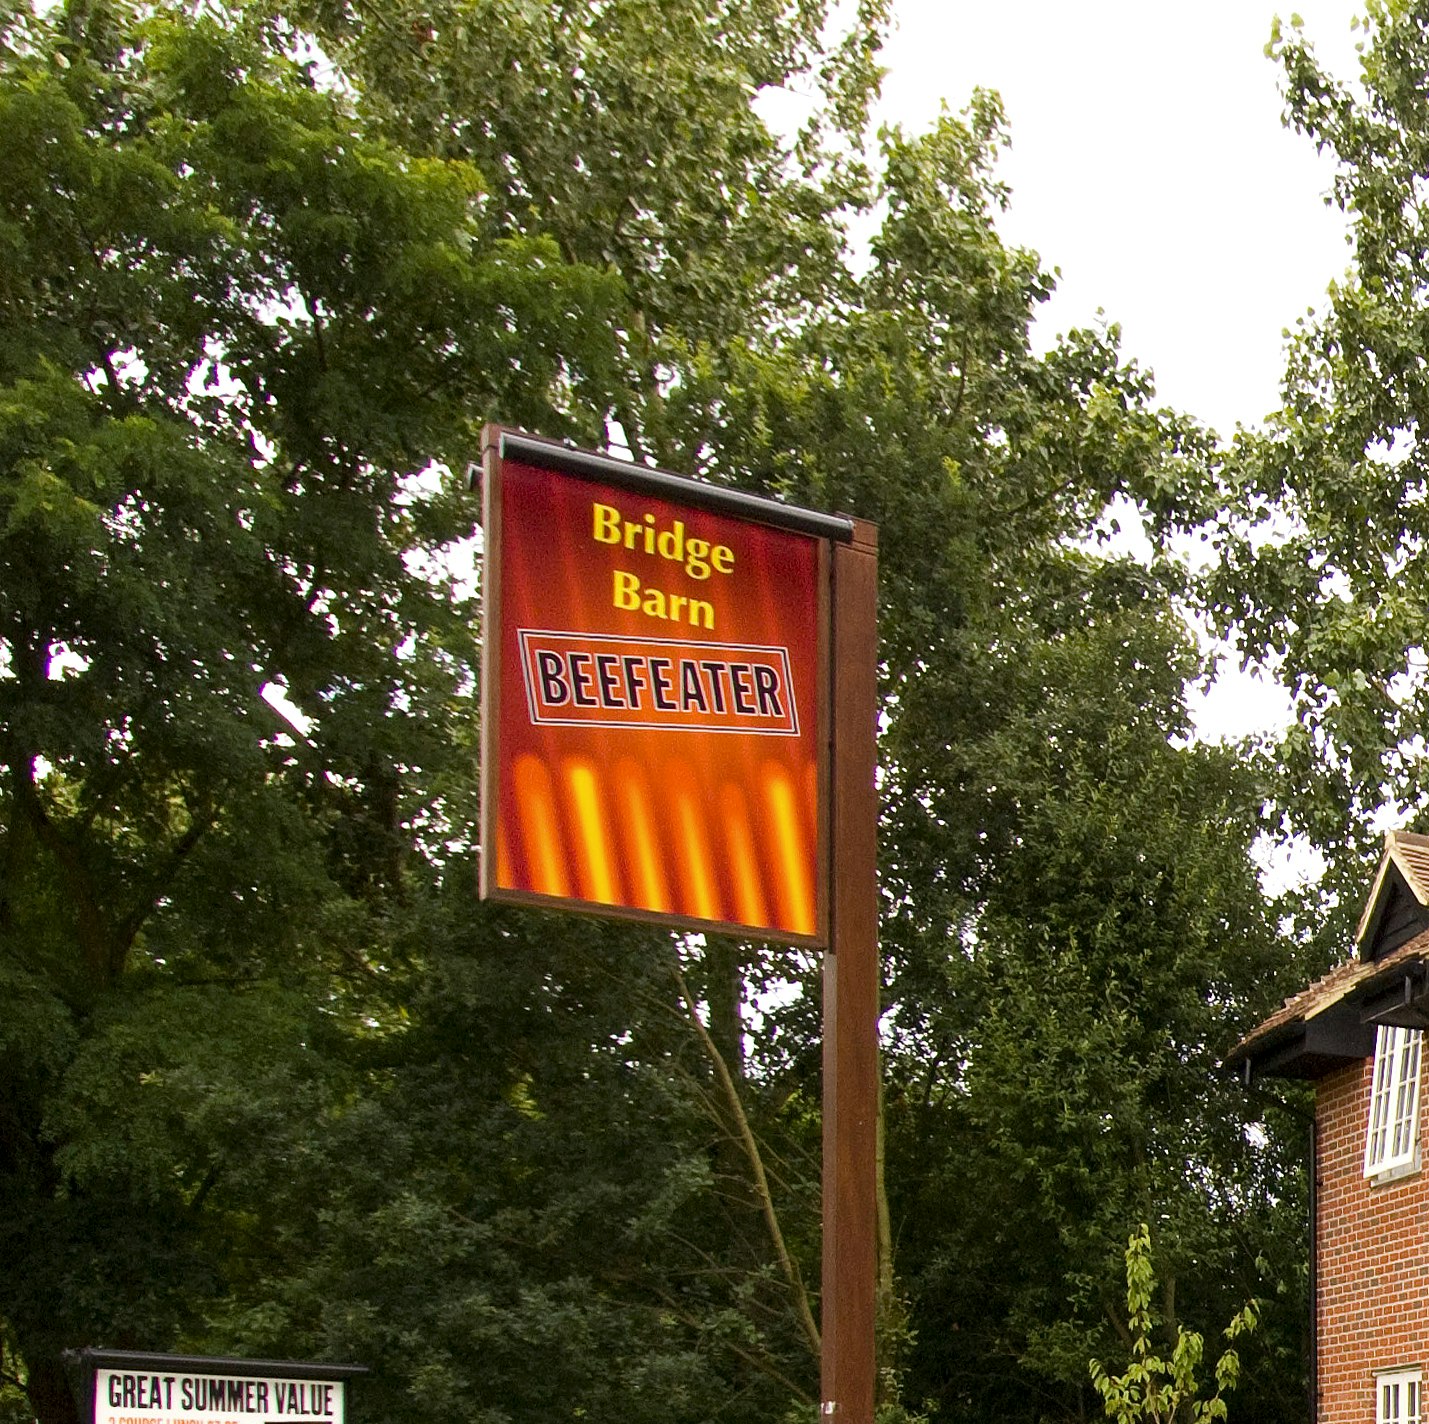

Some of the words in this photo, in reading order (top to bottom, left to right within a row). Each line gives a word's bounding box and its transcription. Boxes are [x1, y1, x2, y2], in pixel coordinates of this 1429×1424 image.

[593, 502, 735, 580] Bridge
[612, 570, 715, 630] Barn
[535, 648, 786, 719] BEEFEATER
[108, 1374, 176, 1410] GREAT
[181, 1378, 269, 1414] SUMMER
[275, 1382, 334, 1416] VALUE
